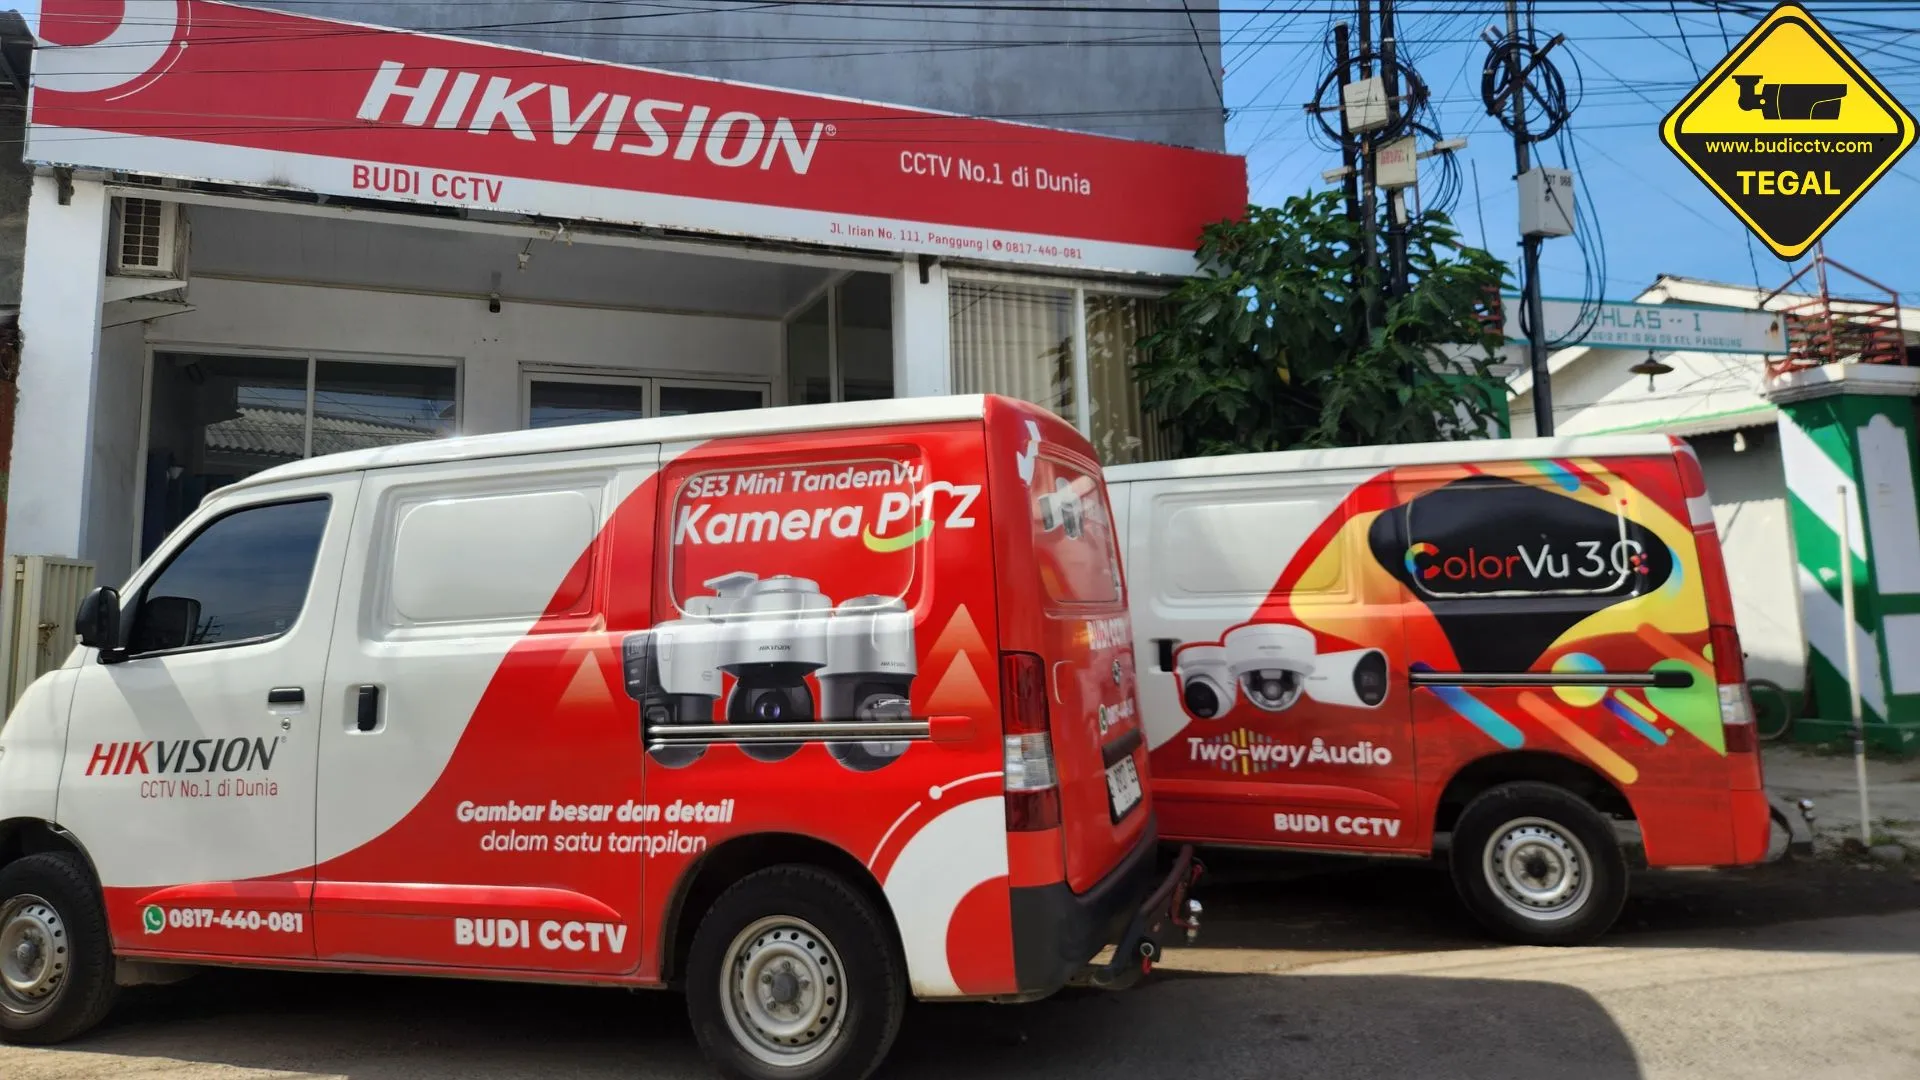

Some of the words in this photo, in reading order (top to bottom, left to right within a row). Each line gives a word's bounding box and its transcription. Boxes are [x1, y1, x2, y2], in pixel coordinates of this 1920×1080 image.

[353, 165, 419, 196] BUDI
[432, 173, 503, 203] CCTV
[900, 151, 952, 178] CCTV
[958, 158, 1003, 185] No.1
[1011, 166, 1029, 188] di
[1036, 168, 1091, 195] Dunia
[848, 224, 874, 238] Irian
[878, 227, 896, 240] No.
[900, 230, 924, 245] 111,
[928, 232, 982, 251] Panggung
[1005, 242, 1083, 259] 0817-440-081
[1692, 313, 1702, 332] I
[686, 474, 729, 498] SE3
[734, 471, 782, 496] Mini
[791, 460, 924, 493] TandemVu
[674, 503, 864, 545] Kamera
[874, 480, 982, 542] PTZ
[1405, 541, 1570, 580] ColorVu
[1576, 539, 1649, 578] 3.0
[1187, 737, 1307, 768] Two-way
[1307, 737, 1393, 766] Audio
[140, 780, 176, 798] CCTV
[181, 779, 211, 797] No.1
[218, 779, 230, 797] di
[236, 778, 278, 796] Dunia
[456, 800, 545, 823] Gambar
[549, 800, 613, 823] besar
[616, 799, 660, 823] dan
[664, 799, 735, 823] detail
[1273, 812, 1329, 833] BUDI
[1335, 815, 1401, 838] CCTV
[480, 829, 548, 852] dalam
[554, 832, 603, 853] satu
[608, 829, 707, 858] tampilan
[168, 908, 304, 933] 0817-440-081
[455, 918, 530, 948] BUDI
[539, 920, 627, 953] CCTV
